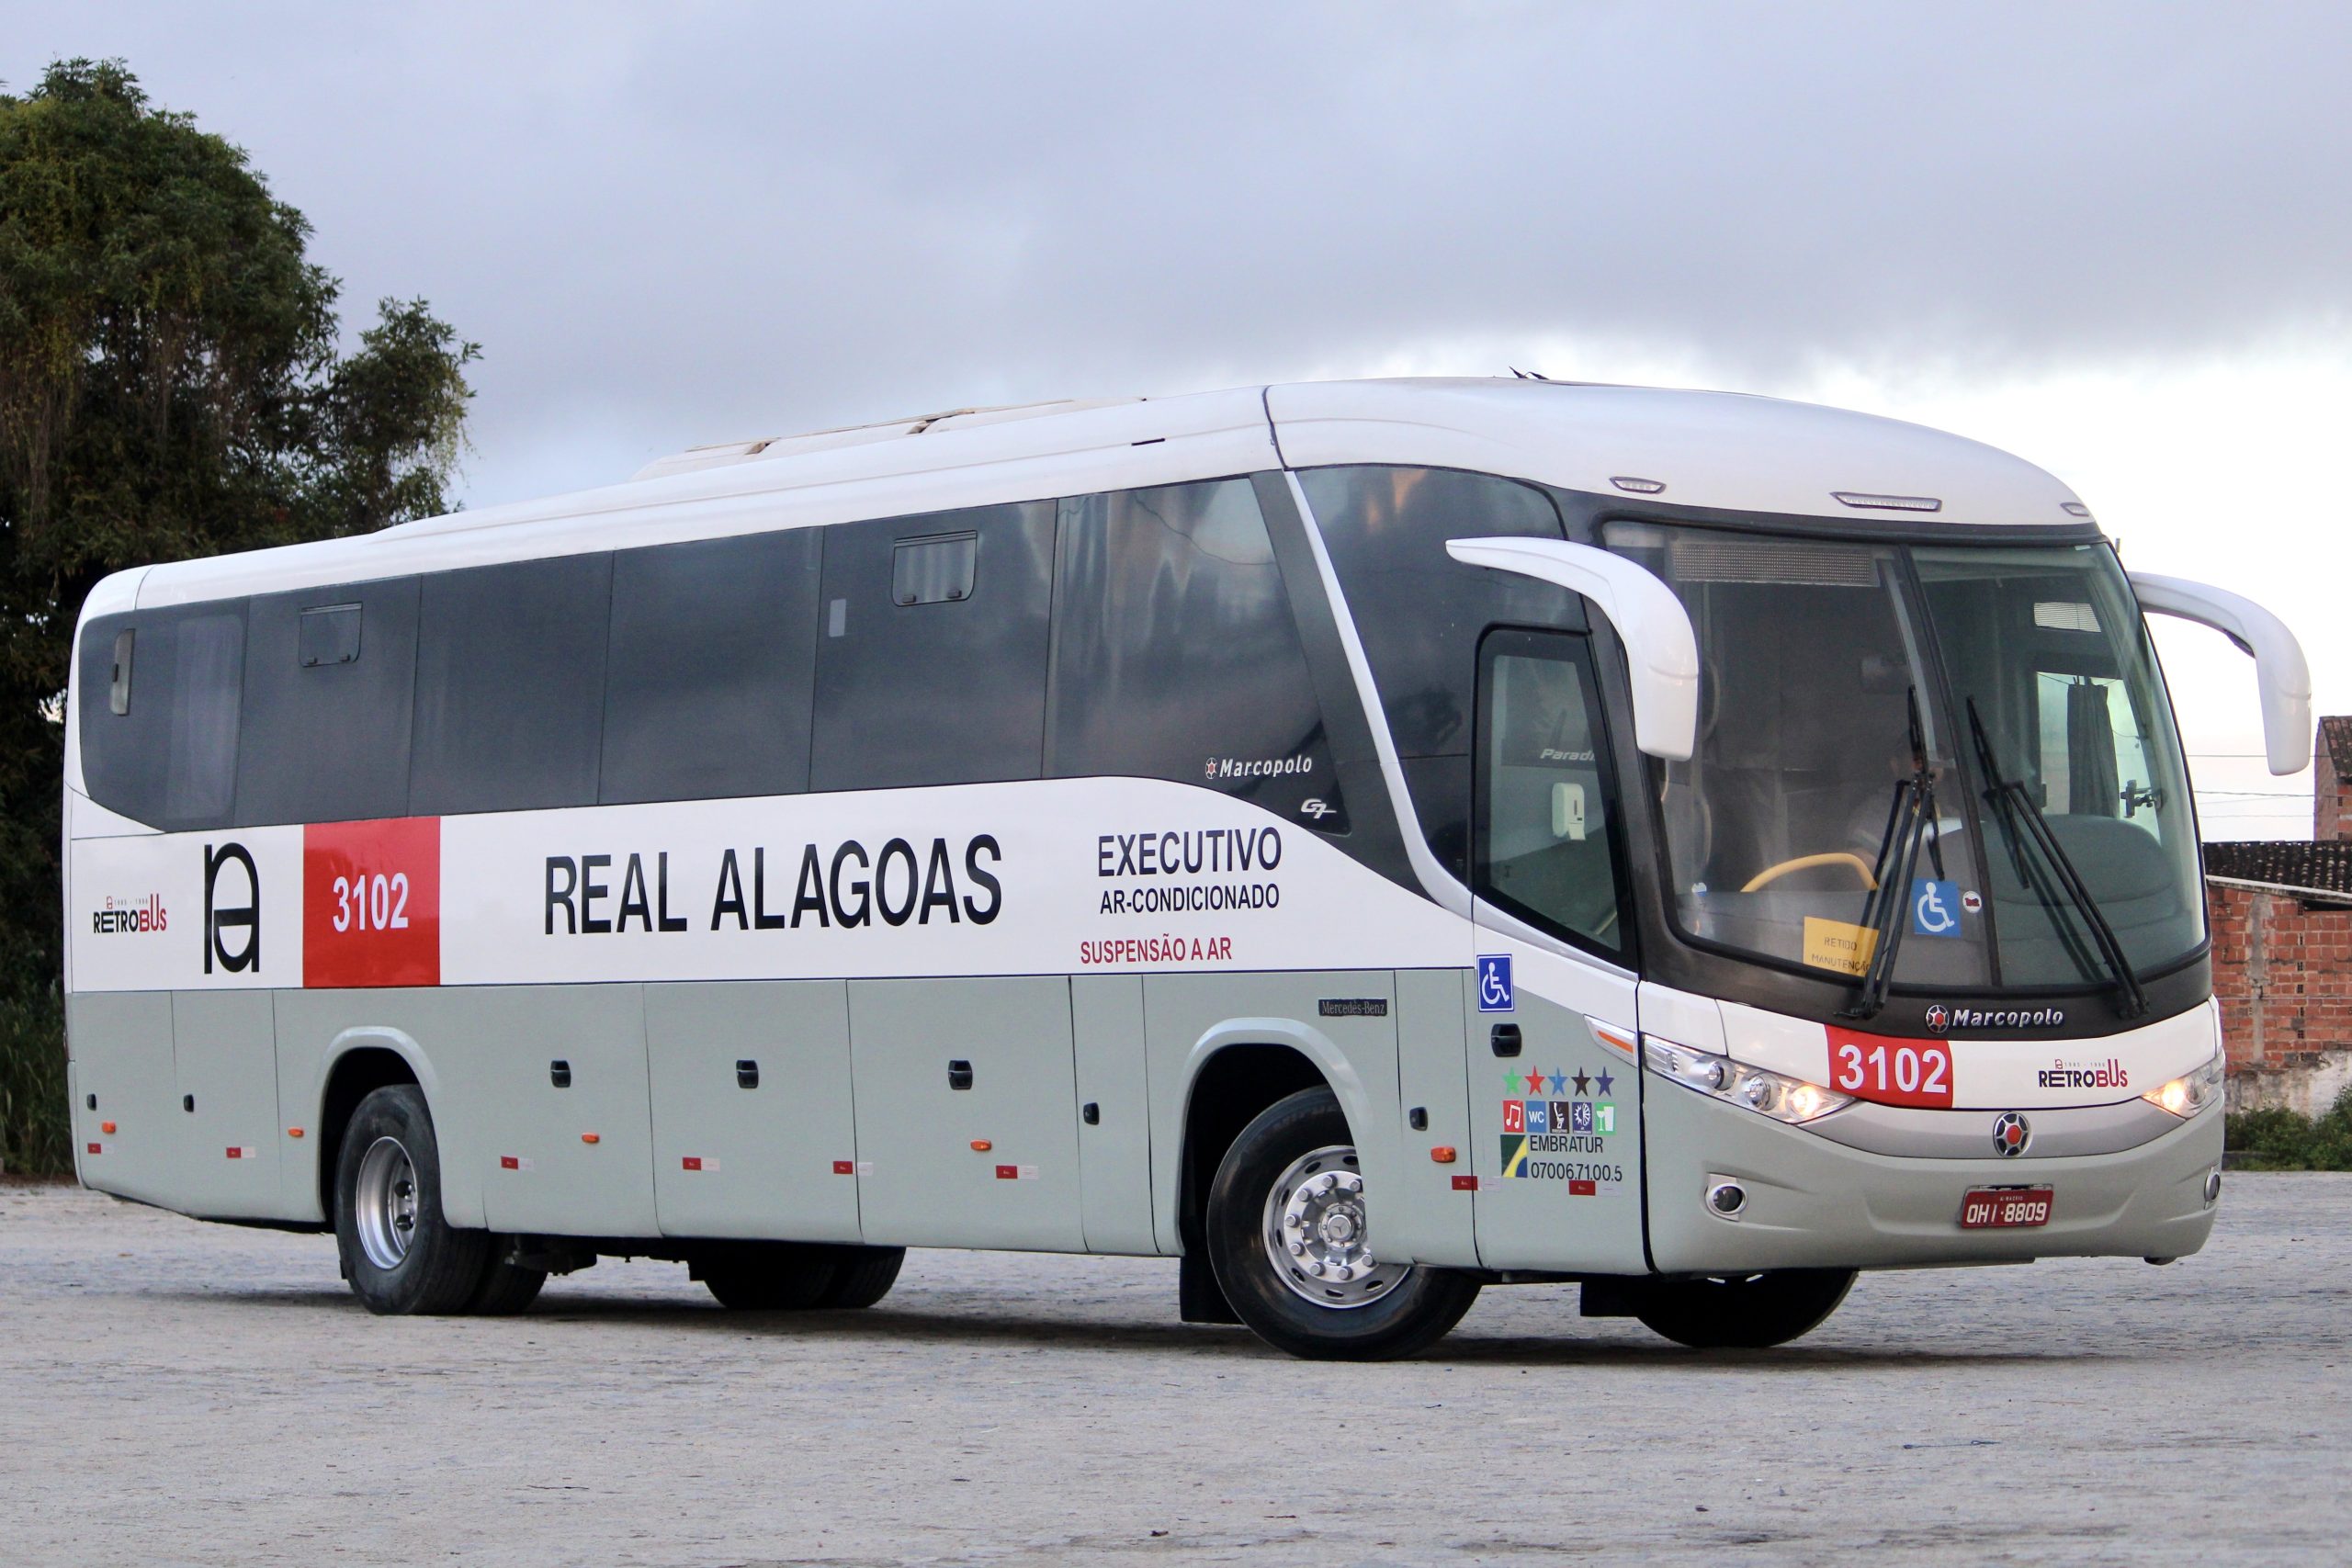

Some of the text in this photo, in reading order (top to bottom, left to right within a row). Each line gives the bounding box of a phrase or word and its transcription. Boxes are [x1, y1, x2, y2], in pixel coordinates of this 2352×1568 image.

[1219, 755, 1312, 778] Marcopolo
[1540, 749, 1595, 761] Paradi
[1098, 827, 1282, 877] EXECUTIVO
[545, 834, 1001, 934] REAL ALAGOAS
[333, 873, 409, 932] 3102
[1100, 883, 1280, 914] AR-CONDICIONADO
[93, 893, 167, 933] RETROBUS
[1080, 933, 1232, 964] SUSPENSÃO A AR
[1824, 937, 1858, 952] RETIDO
[1322, 1000, 1385, 1014] Mercedes-Benz
[1952, 1009, 2064, 1028] Marcopolo
[1838, 1044, 1948, 1094] 3102
[2038, 1058, 2128, 1088] RETROBUS
[1528, 1111, 1544, 1123] WC
[1530, 1135, 1603, 1153] EMBRATUR
[1531, 1162, 1623, 1182] 07006.71.00.5
